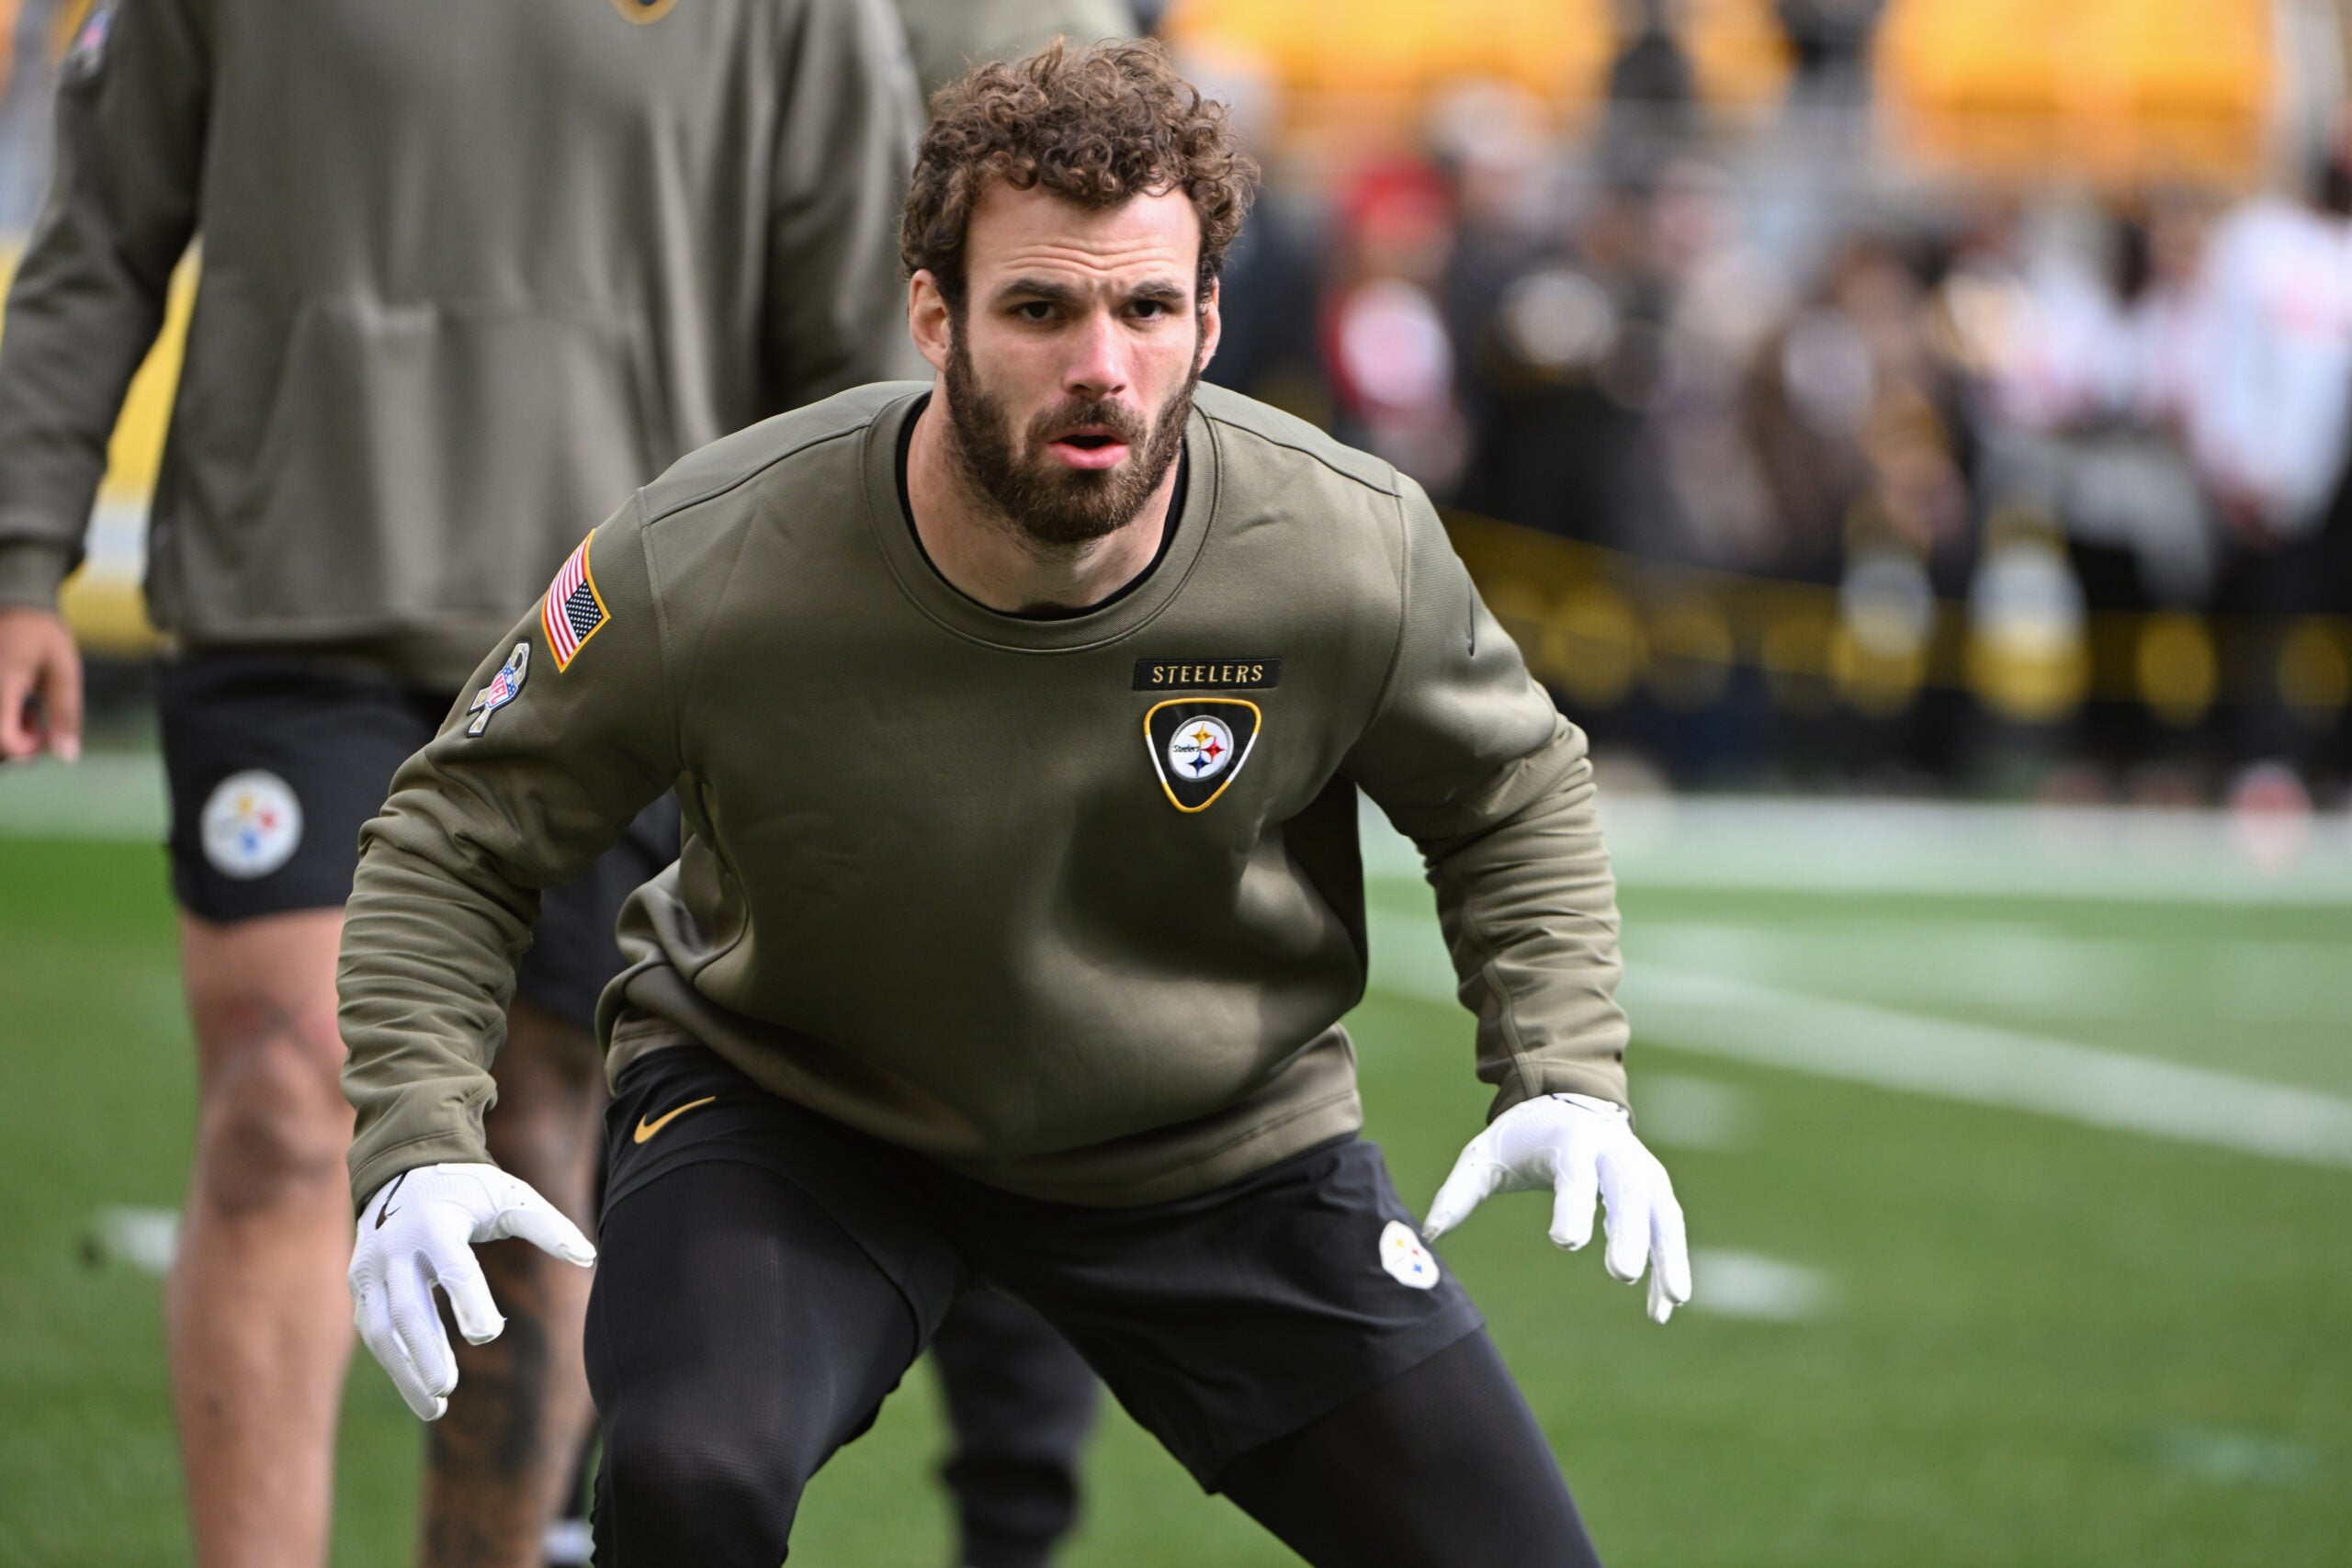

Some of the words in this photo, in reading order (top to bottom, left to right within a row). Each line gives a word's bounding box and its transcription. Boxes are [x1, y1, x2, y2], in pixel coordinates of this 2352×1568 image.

[1151, 664, 1264, 684] STEELERS
[490, 674, 508, 705] NFL
[1172, 744, 1200, 753] Steelers
